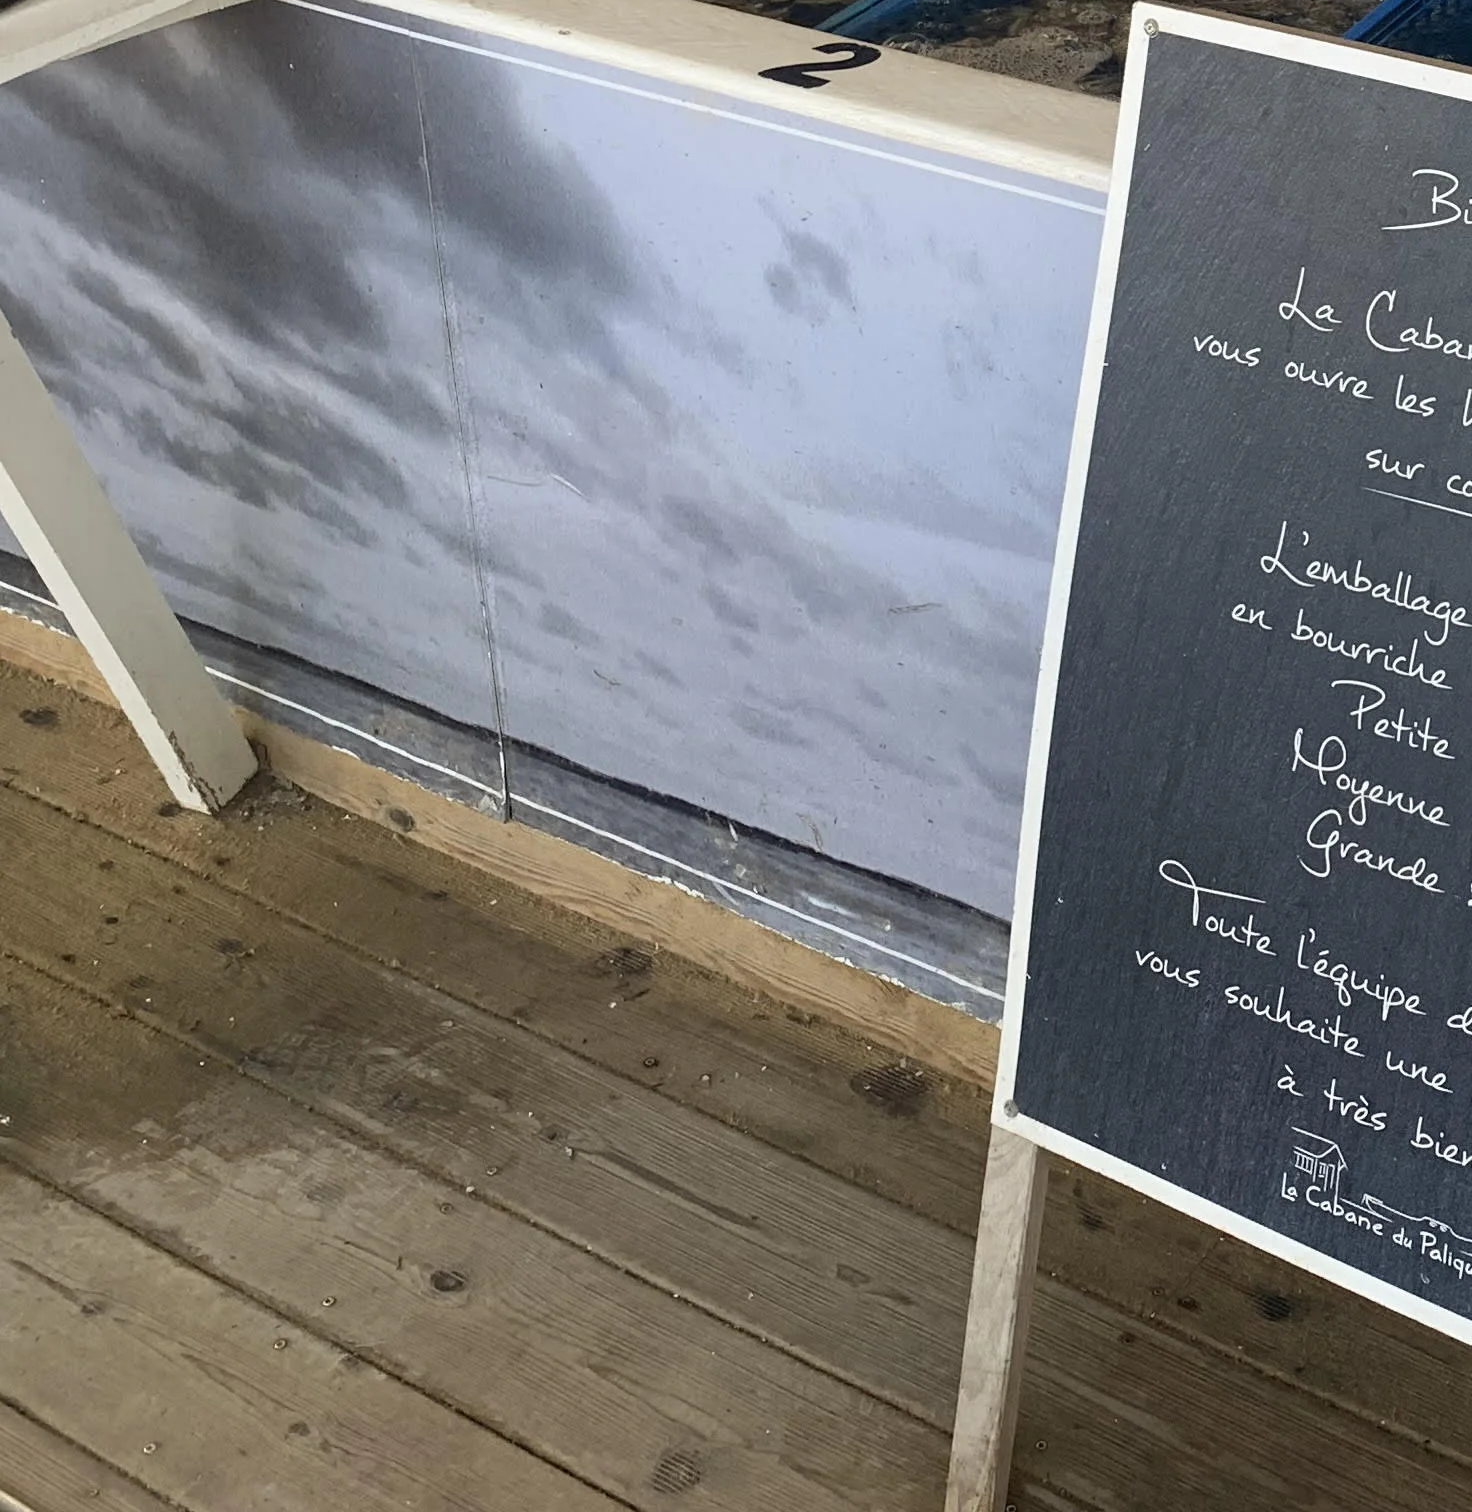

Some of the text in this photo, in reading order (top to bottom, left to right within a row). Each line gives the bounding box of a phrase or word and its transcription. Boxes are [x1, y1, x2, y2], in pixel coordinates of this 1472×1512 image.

[757, 42, 882, 89] 2
[1279, 267, 1343, 332] La
[1193, 335, 1262, 368] vous
[1284, 360, 1375, 401] ouvre
[1394, 373, 1437, 419] les
[1365, 448, 1426, 481] sur
[1260, 521, 1472, 645] L'emballage
[1231, 602, 1273, 631] en
[1291, 609, 1452, 690] bourriche
[1331, 679, 1456, 761] Petite
[1291, 727, 1450, 826] Moyenne
[1296, 808, 1446, 894] Grande
[1158, 859, 1277, 957] Toute
[1296, 928, 1427, 1021] l'équipe
[1135, 947, 1201, 989] vous
[1224, 984, 1365, 1058] souhaite
[1386, 1049, 1453, 1094] une
[1277, 1063, 1304, 1097] à
[1323, 1085, 1387, 1131] très
[1281, 1172, 1298, 1202] La
[1305, 1185, 1384, 1236] Cabane
[1392, 1227, 1412, 1249] du
